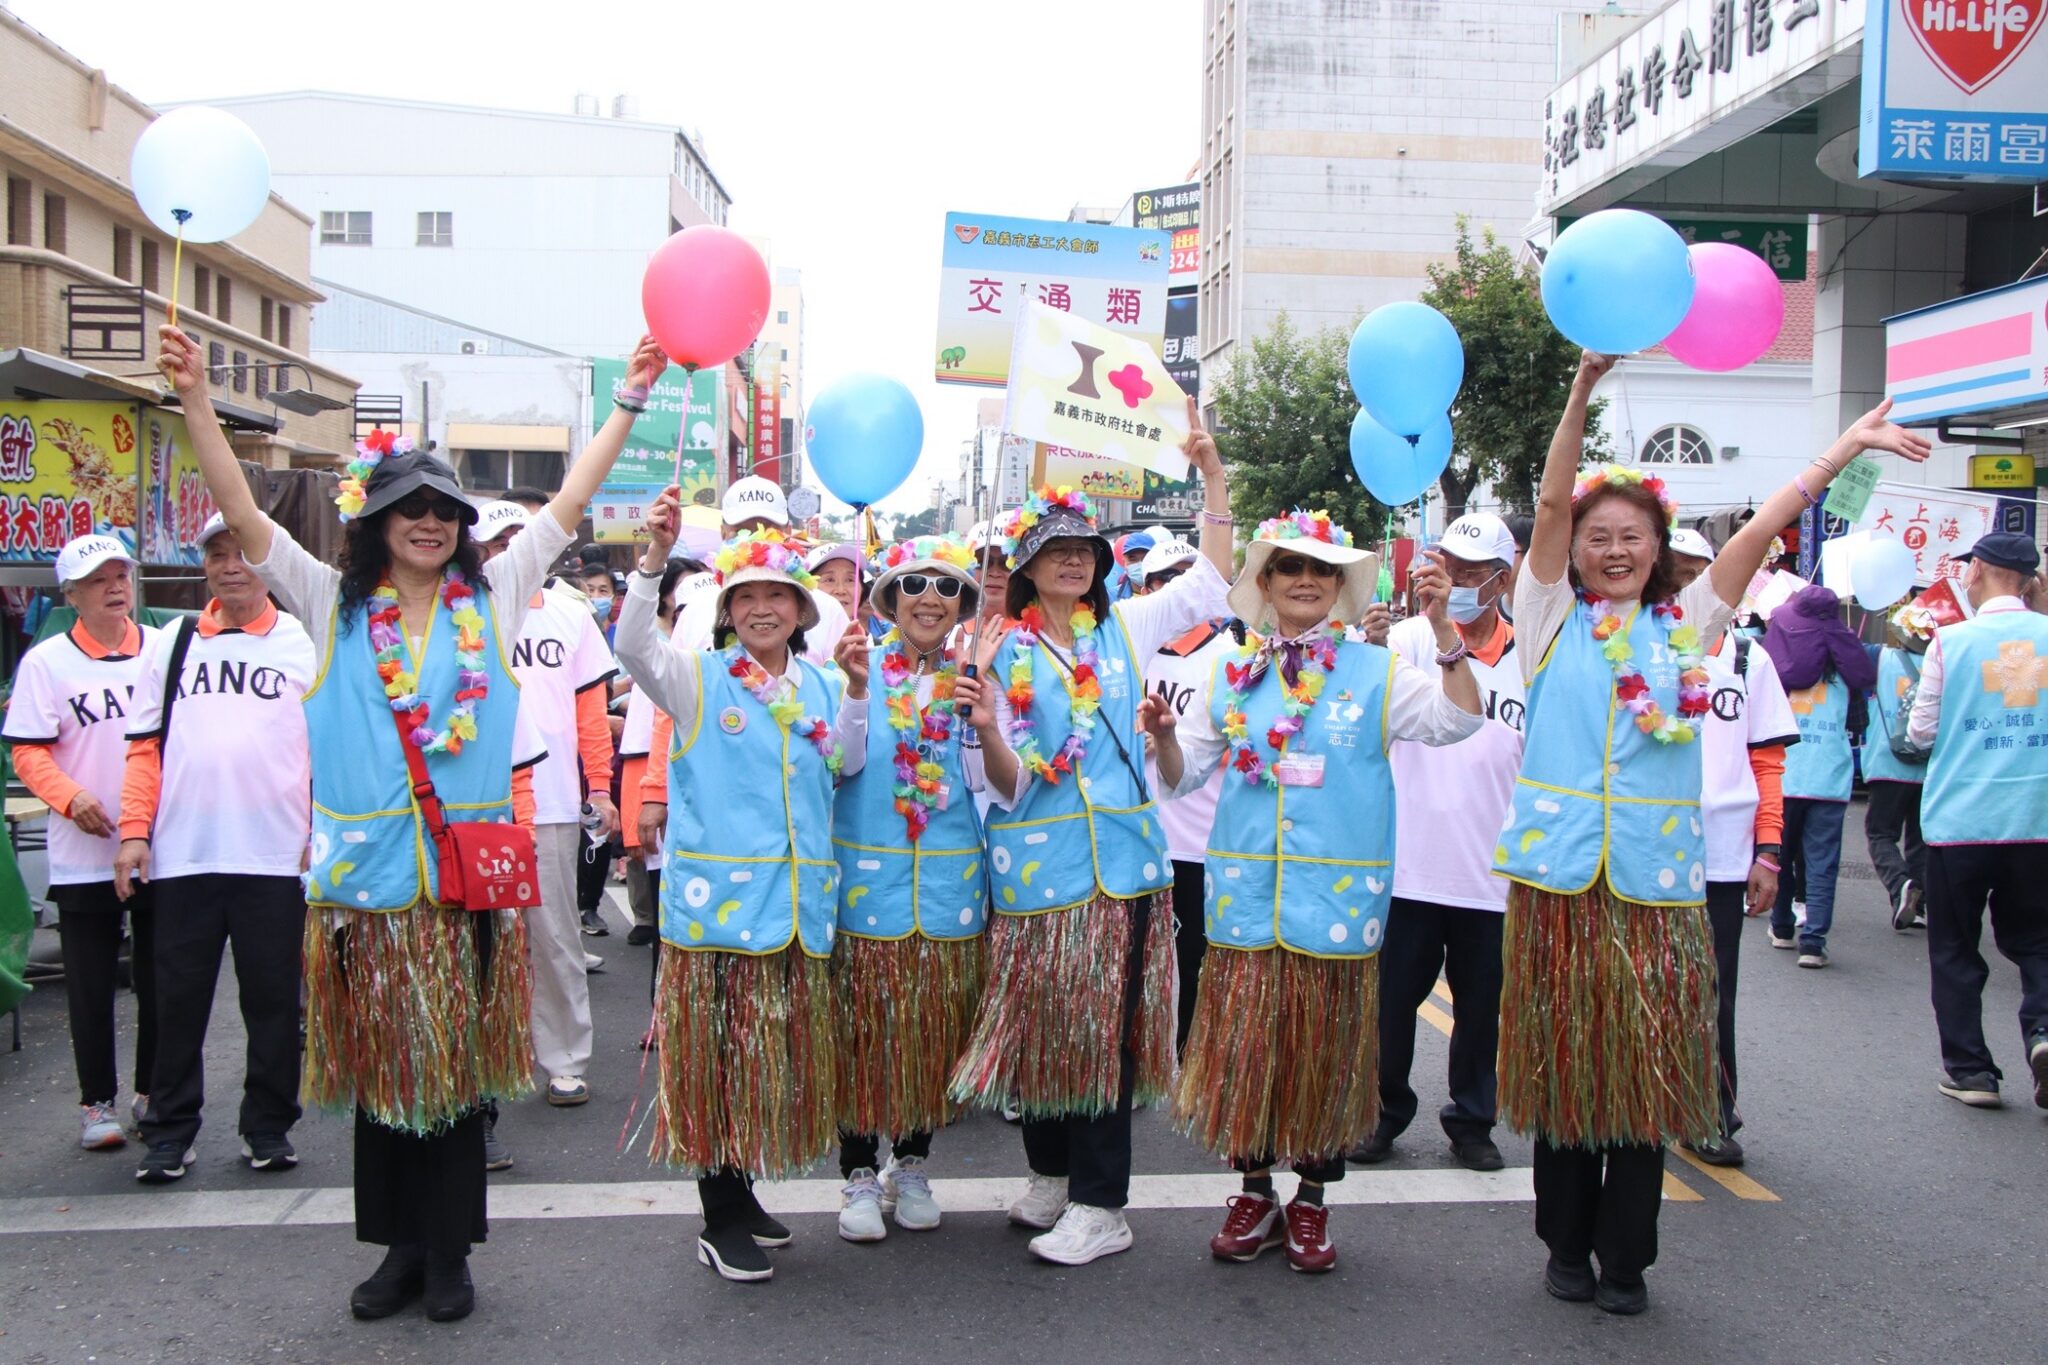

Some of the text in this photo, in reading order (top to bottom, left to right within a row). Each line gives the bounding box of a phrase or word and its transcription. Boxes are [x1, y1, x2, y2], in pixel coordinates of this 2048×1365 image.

[1922, 0, 2029, 50] Hi-Life
[1890, 119, 2047, 165] 萊爾富
[983, 230, 1099, 254] 嘉義市志工大會師
[1053, 400, 1162, 442] 嘉義市政府社會處
[738, 489, 775, 504] KANO
[487, 507, 524, 522] KANO
[78, 541, 118, 558] KANO
[1165, 545, 1193, 556] KAN
[1328, 733, 1357, 748] 志工
